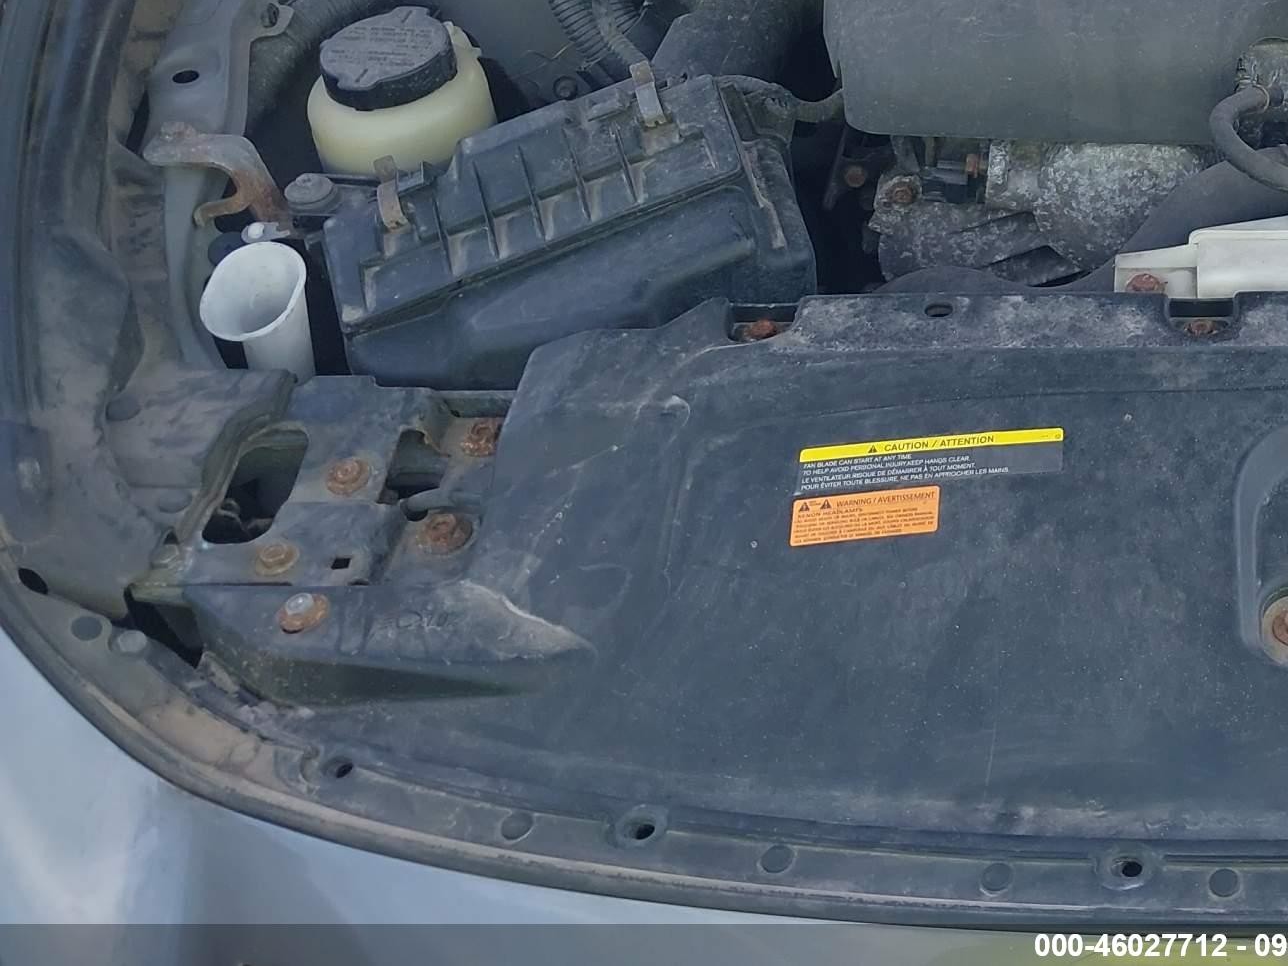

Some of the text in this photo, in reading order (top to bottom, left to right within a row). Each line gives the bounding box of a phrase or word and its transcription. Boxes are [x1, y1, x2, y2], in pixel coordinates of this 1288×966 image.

[884, 441, 929, 451] CAUTION
[940, 435, 994, 447] ATTENTION
[810, 474, 850, 483] VENTILATEUR
[837, 498, 871, 507] WARNING
